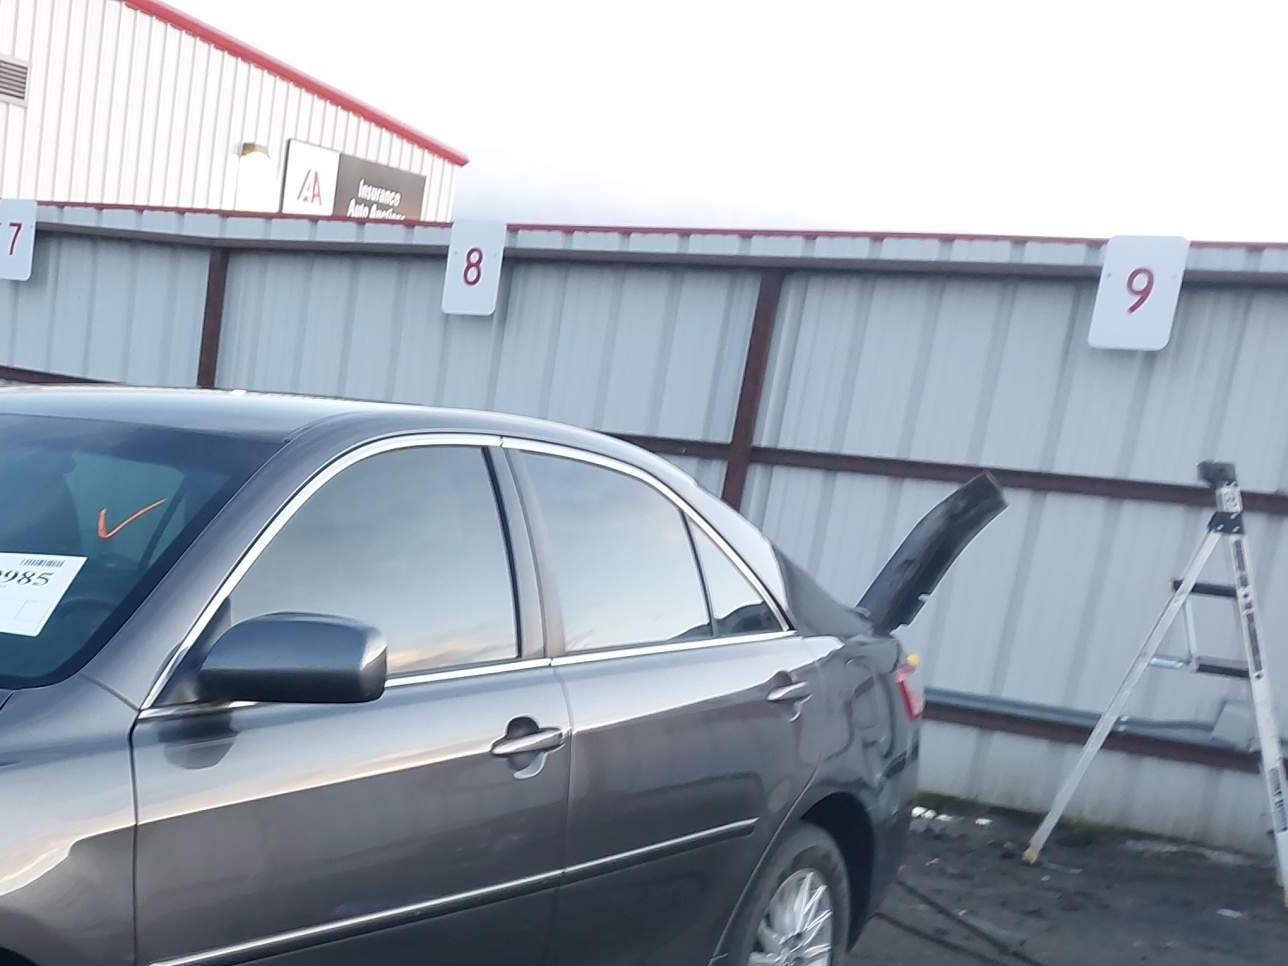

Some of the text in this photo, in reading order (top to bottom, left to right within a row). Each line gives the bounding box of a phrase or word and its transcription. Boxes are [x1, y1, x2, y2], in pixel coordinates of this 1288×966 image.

[346, 198, 369, 218] Auto
[357, 178, 401, 207] Insurance
[8, 222, 22, 256] 7
[463, 247, 483, 286] 8
[1126, 267, 1155, 314] 9
